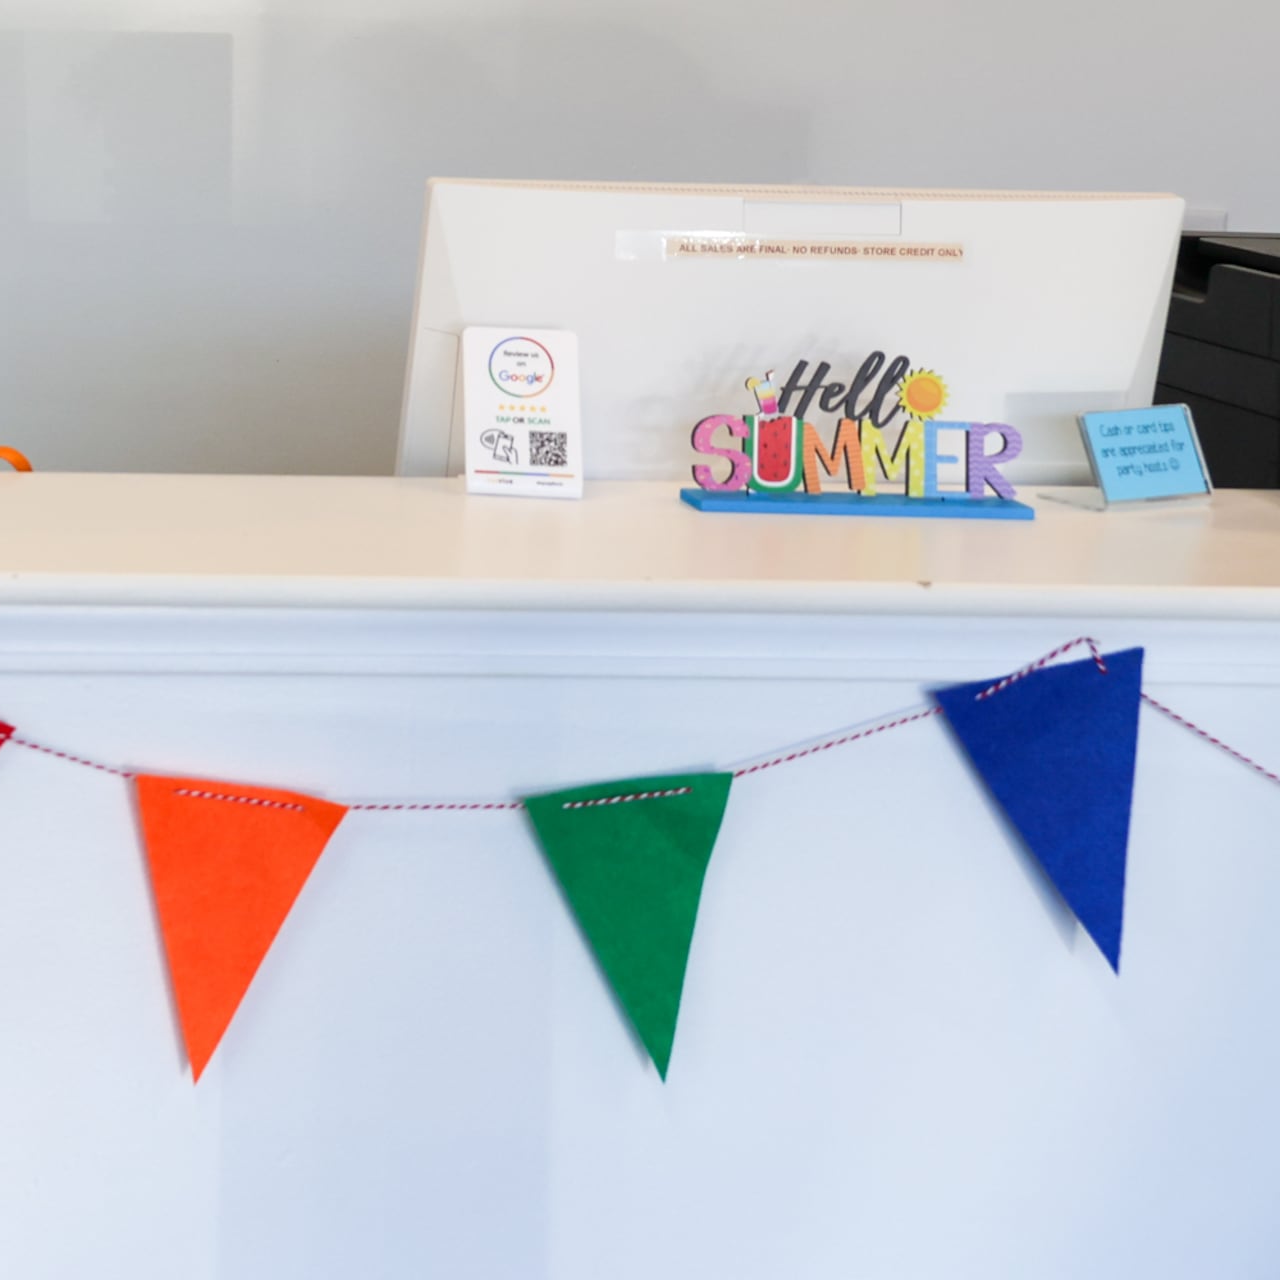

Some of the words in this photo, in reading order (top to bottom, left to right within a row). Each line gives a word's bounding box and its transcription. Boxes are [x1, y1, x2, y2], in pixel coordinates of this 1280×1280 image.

[680, 244, 697, 253] ALL
[700, 244, 734, 254] SALES
[736, 245, 756, 254] ARE
[792, 246, 808, 254] NO
[863, 247, 896, 256] STORE
[900, 248, 935, 256] CREDIT
[938, 248, 964, 257] ONLY
[503, 350, 529, 358] Review
[498, 370, 544, 385] Google
[496, 416, 512, 424] TAP
[512, 416, 525, 424] OR
[691, 413, 1024, 500] SUMMER
